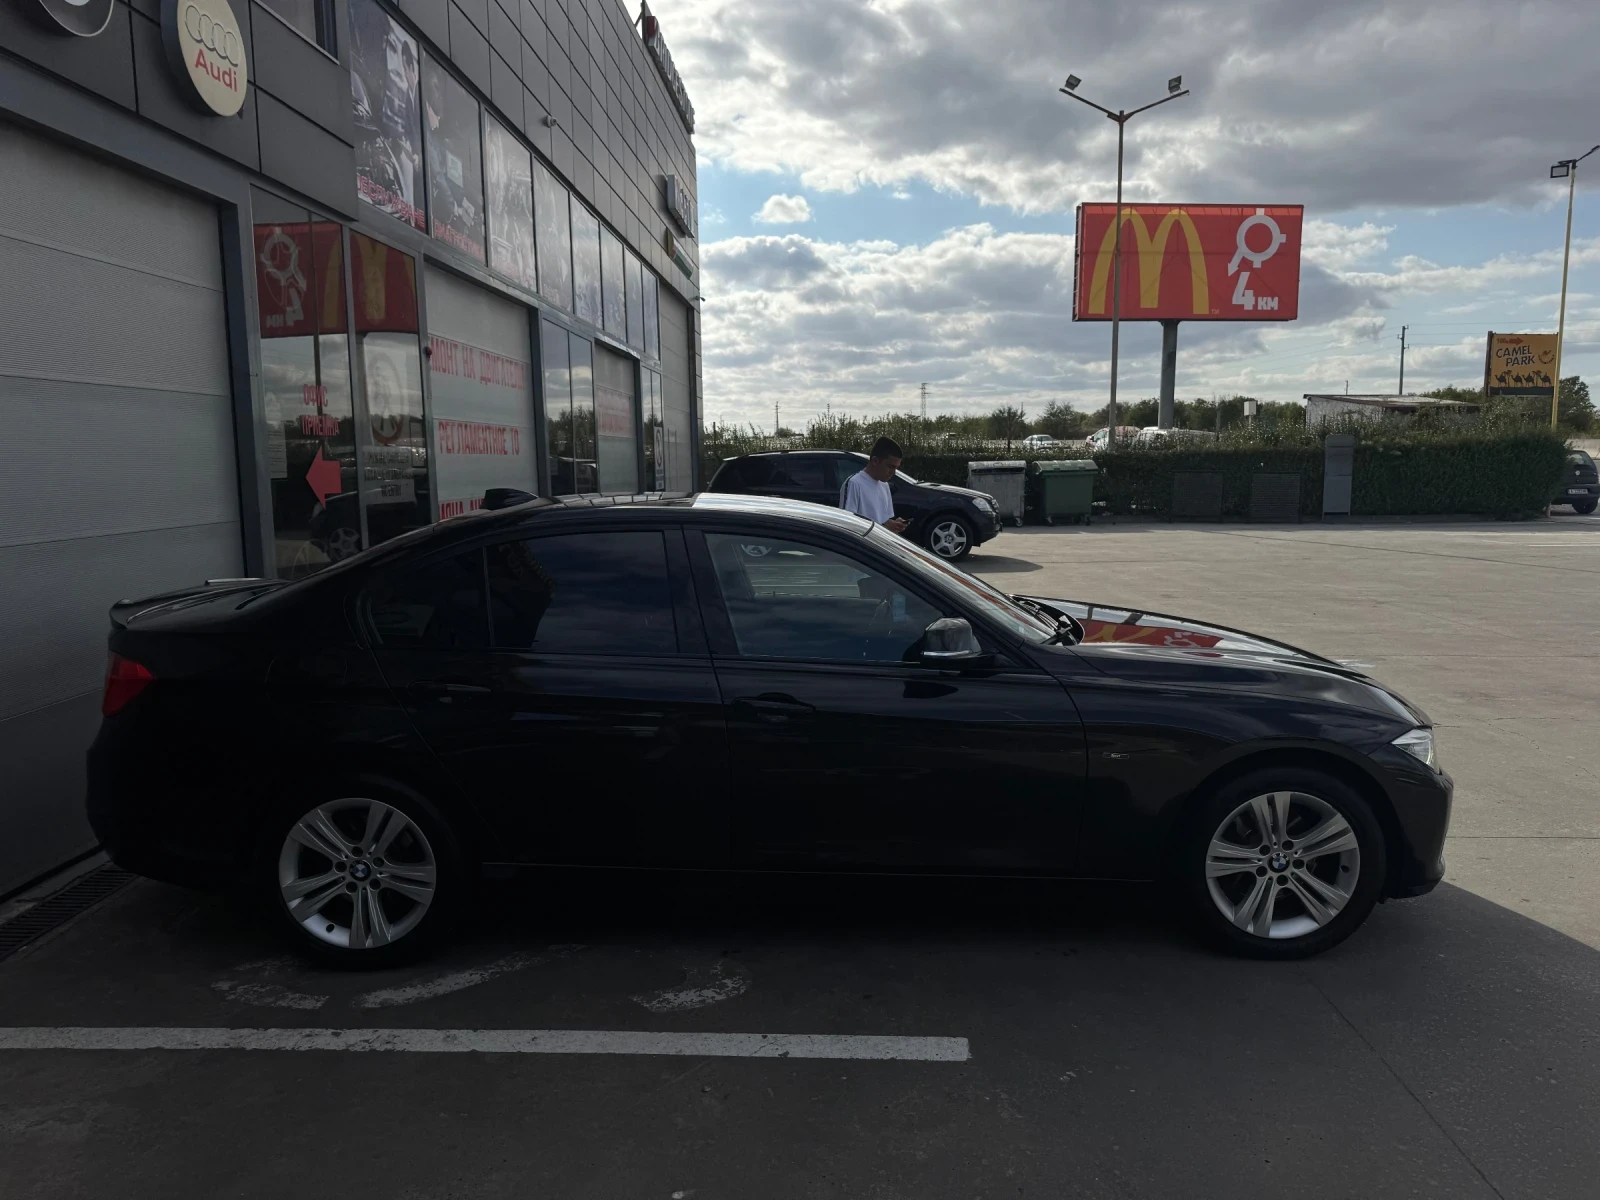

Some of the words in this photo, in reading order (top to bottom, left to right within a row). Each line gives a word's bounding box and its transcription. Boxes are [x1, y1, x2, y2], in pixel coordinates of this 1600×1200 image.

[195, 48, 238, 92] Audi
[1232, 272, 1255, 310] 4
[462, 345, 476, 380] НА
[1496, 345, 1532, 358] CAMEL
[1506, 355, 1535, 367] PARK
[303, 384, 328, 407] ОФИС
[302, 414, 340, 436] ПРИЕМНА
[510, 427, 520, 455] ТО
